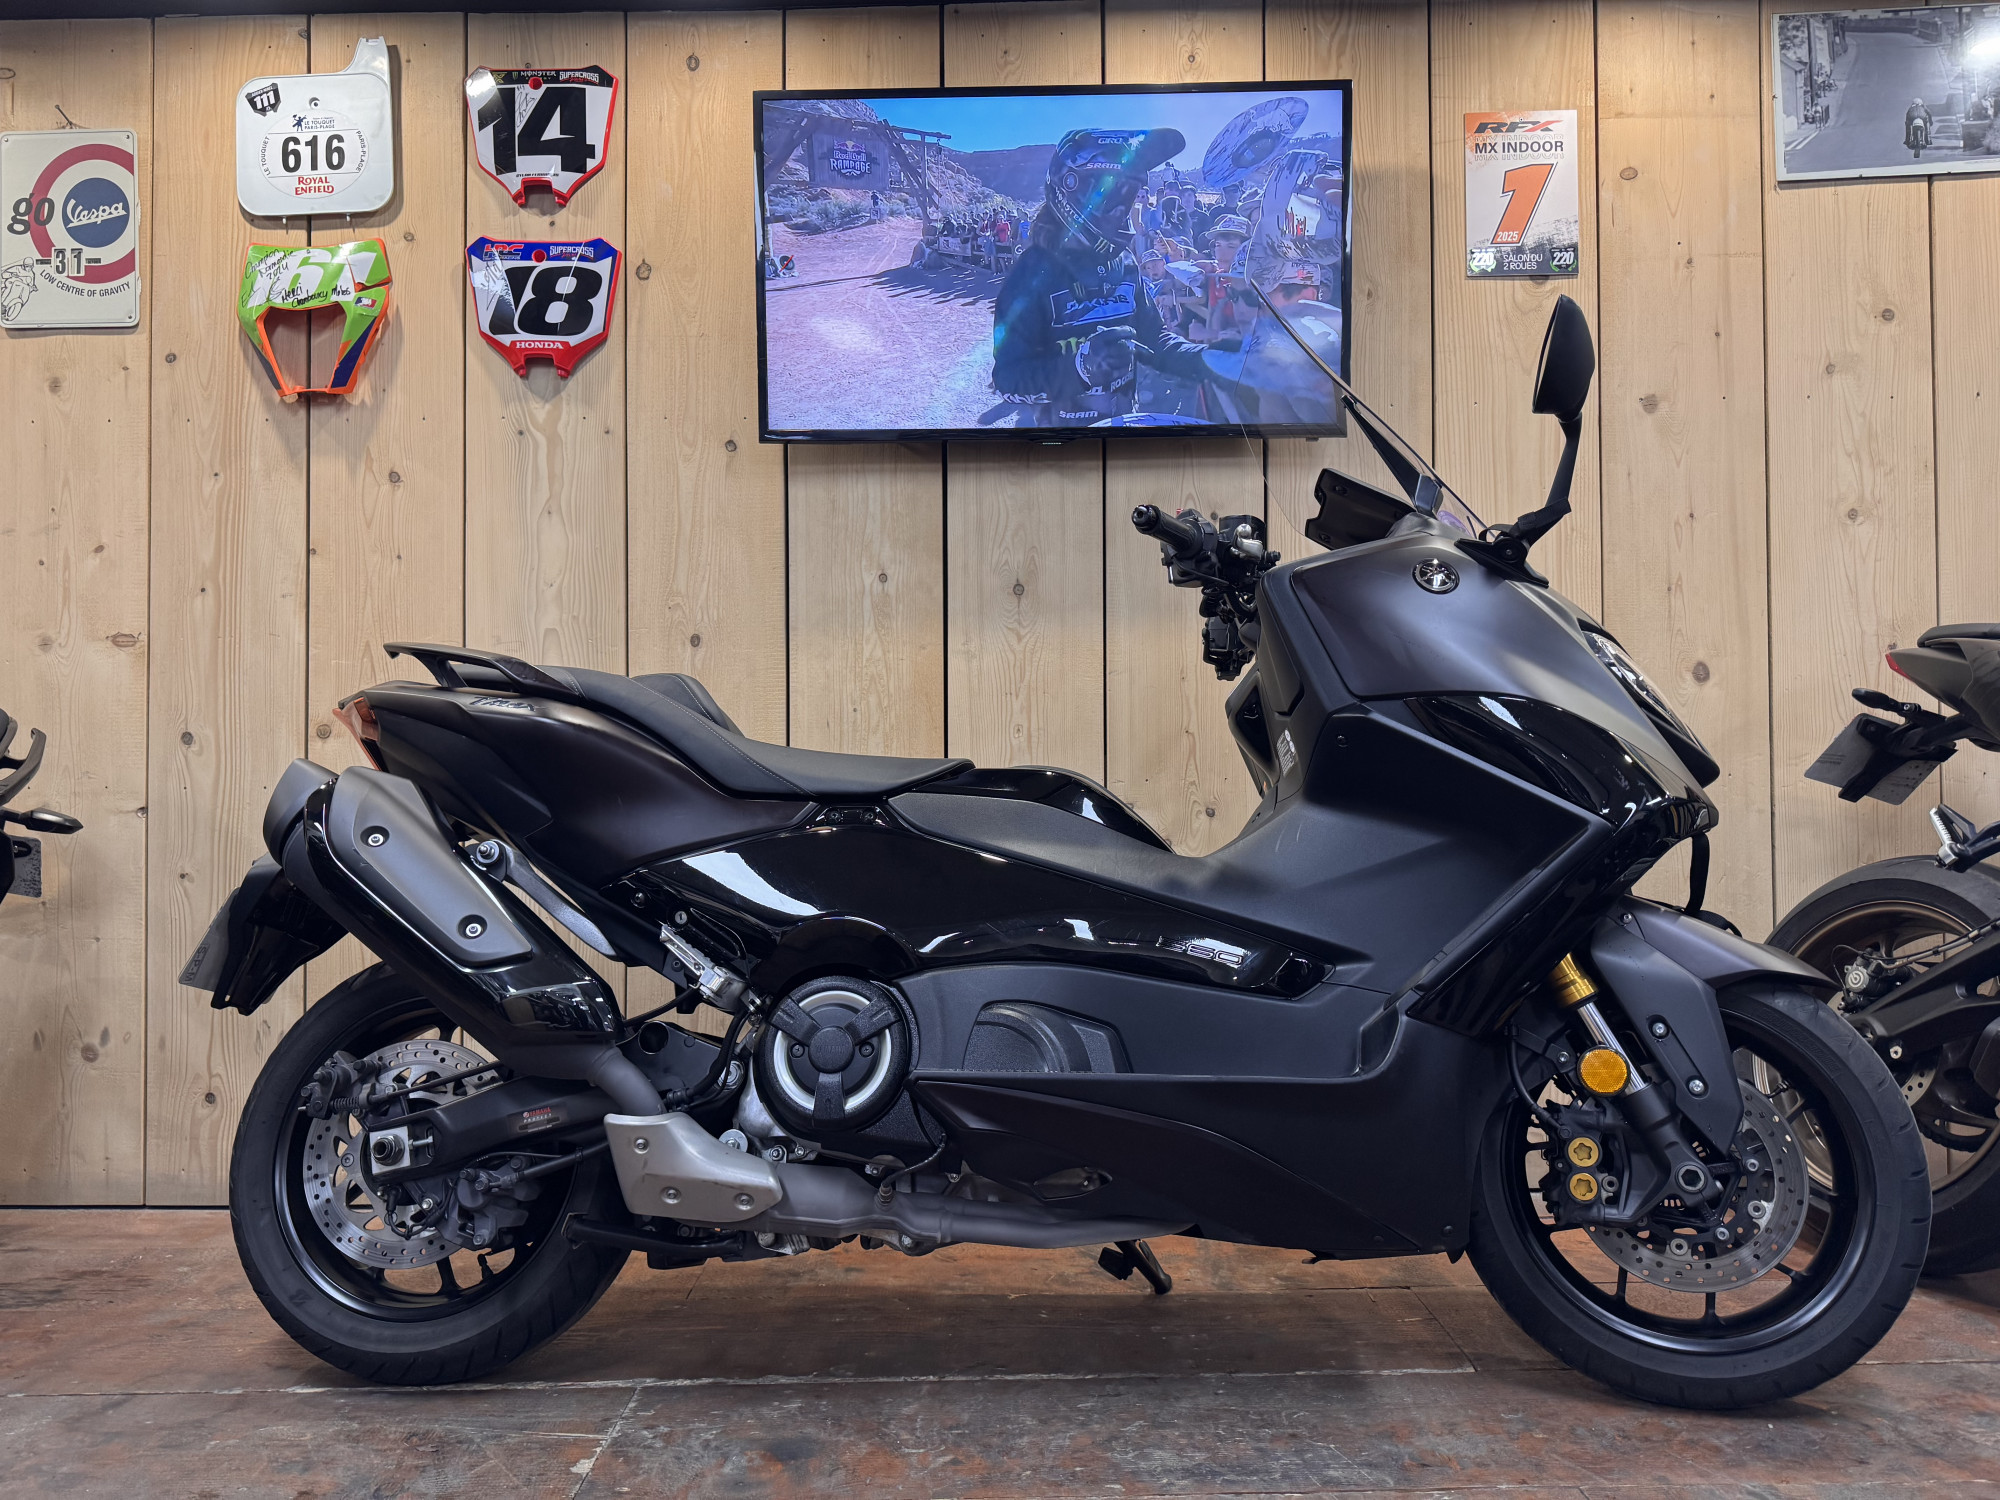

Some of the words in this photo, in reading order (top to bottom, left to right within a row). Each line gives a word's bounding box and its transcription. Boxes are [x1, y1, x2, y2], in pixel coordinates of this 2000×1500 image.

[559, 71, 600, 83] SUPERCROSS
[253, 90, 276, 110] 111
[478, 86, 596, 176] 14
[1474, 119, 1564, 134] RFX
[281, 133, 345, 174] 616
[1474, 141, 1498, 154] MX
[1502, 140, 1564, 154] INDOOR
[830, 158, 871, 174] RAMPAGE
[1084, 162, 1121, 170] SRAM
[297, 176, 331, 186] ROYAL
[294, 185, 335, 196] ENFIELD
[1491, 163, 1555, 246] 1
[7, 193, 56, 235] go
[66, 198, 128, 228] Vespa
[1497, 231, 1520, 242] 2025
[549, 245, 594, 258] SUPERCROSS
[1471, 251, 1495, 266] 220
[1503, 253, 1530, 262] SALON
[1531, 253, 1543, 262] DU
[1553, 251, 1575, 266] 220
[1510, 262, 1538, 270] ROUES
[39, 269, 57, 285] LOW
[56, 280, 86, 297] CENTRE
[86, 289, 98, 298] OF
[99, 281, 131, 298] GRAVITY
[488, 265, 603, 337] 18
[515, 341, 564, 350] HONDA
[1059, 410, 1099, 419] SRAM
